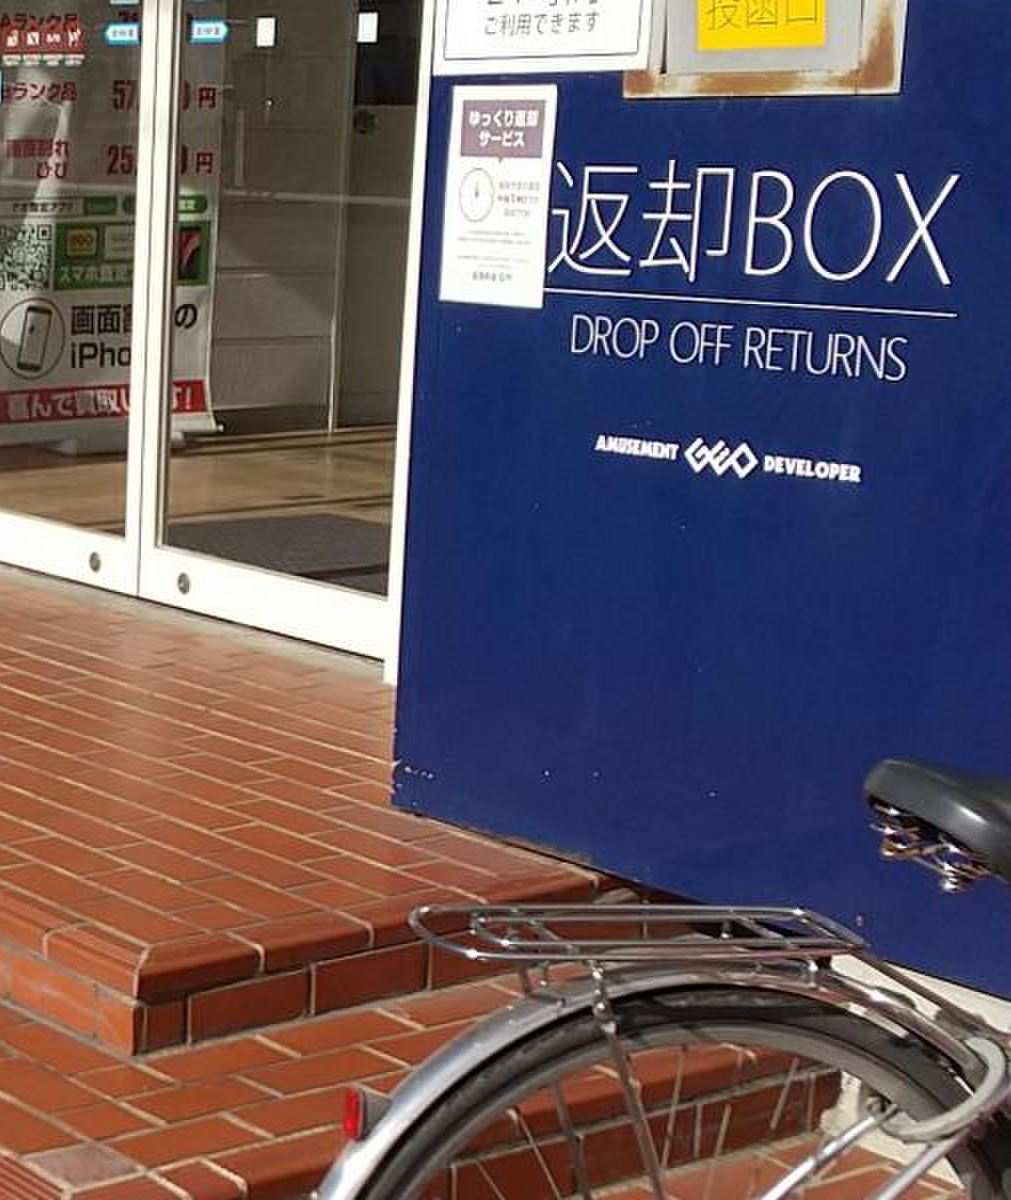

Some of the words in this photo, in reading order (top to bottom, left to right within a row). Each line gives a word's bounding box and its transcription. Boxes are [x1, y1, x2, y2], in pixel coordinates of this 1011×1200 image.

[484, 11, 600, 37] ご利用できます
[479, 130, 525, 147] サービス
[548, 160, 959, 285] 返却BOX
[571, 314, 659, 359] DROP
[669, 320, 733, 365] OFF
[743, 326, 908, 381] RETURNS
[595, 434, 679, 460] AMUSEMENT
[684, 436, 758, 478] GEO
[764, 455, 861, 482] DEVELOPER
